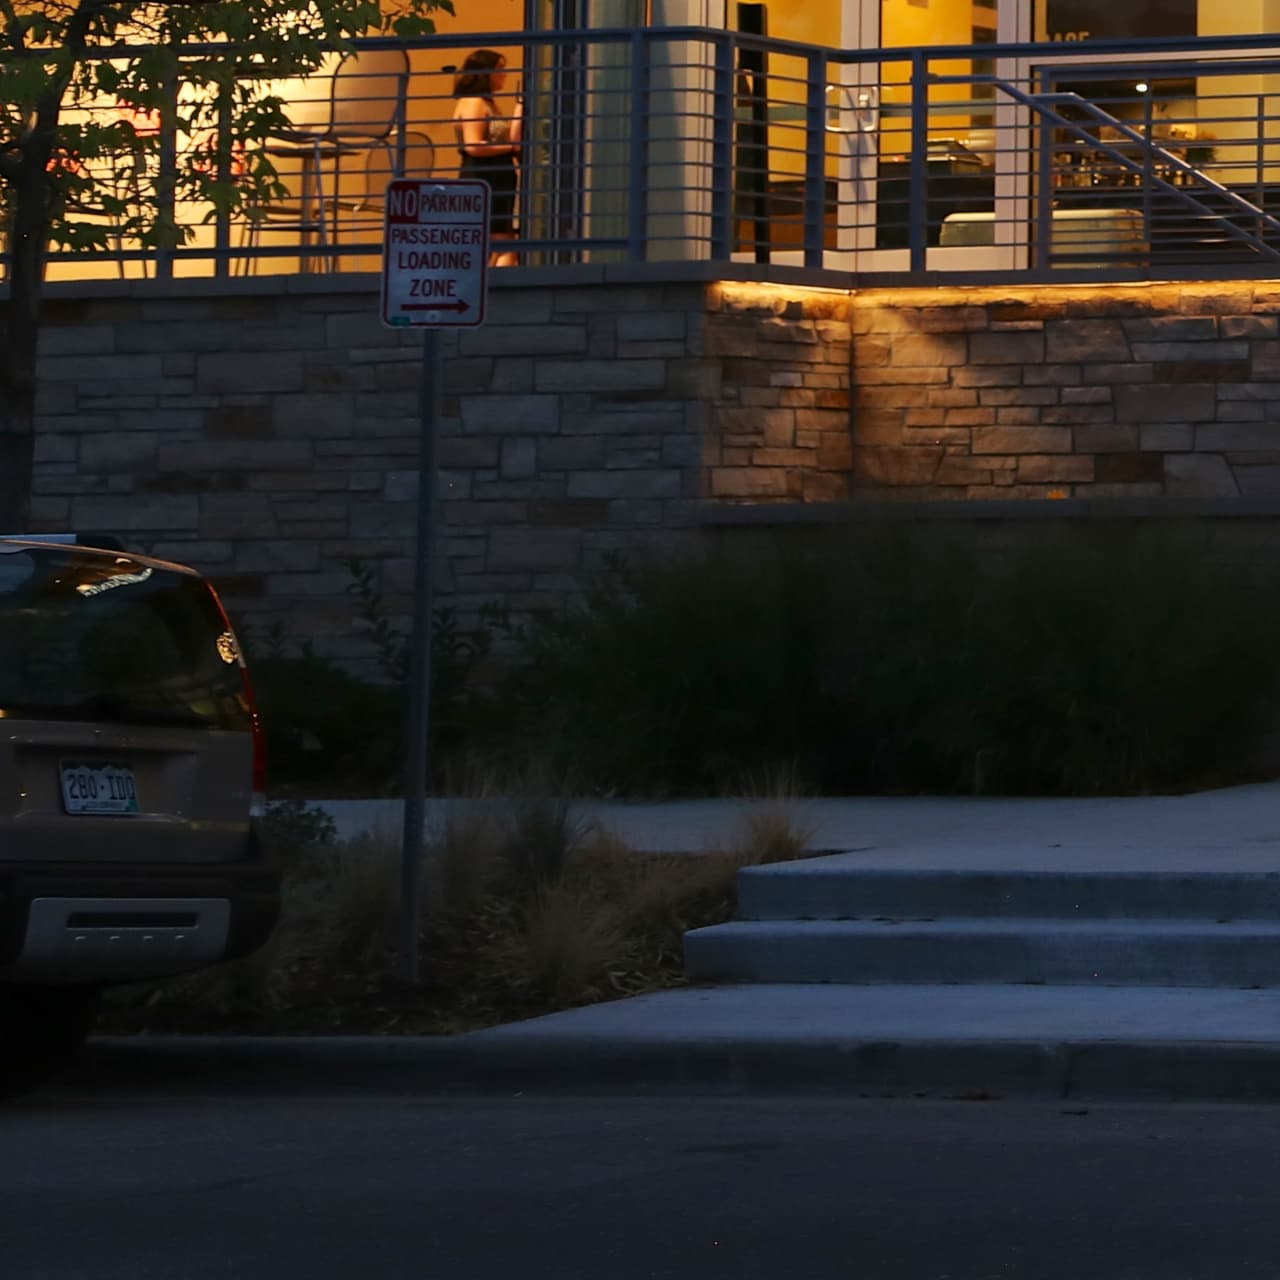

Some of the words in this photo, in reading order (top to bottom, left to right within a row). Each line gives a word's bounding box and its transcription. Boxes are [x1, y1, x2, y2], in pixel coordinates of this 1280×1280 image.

[390, 189, 417, 217] NO
[421, 194, 481, 213] PARKING
[391, 228, 481, 245] PASSENGER
[398, 251, 472, 269] LOADING
[409, 279, 457, 297] ZONE
